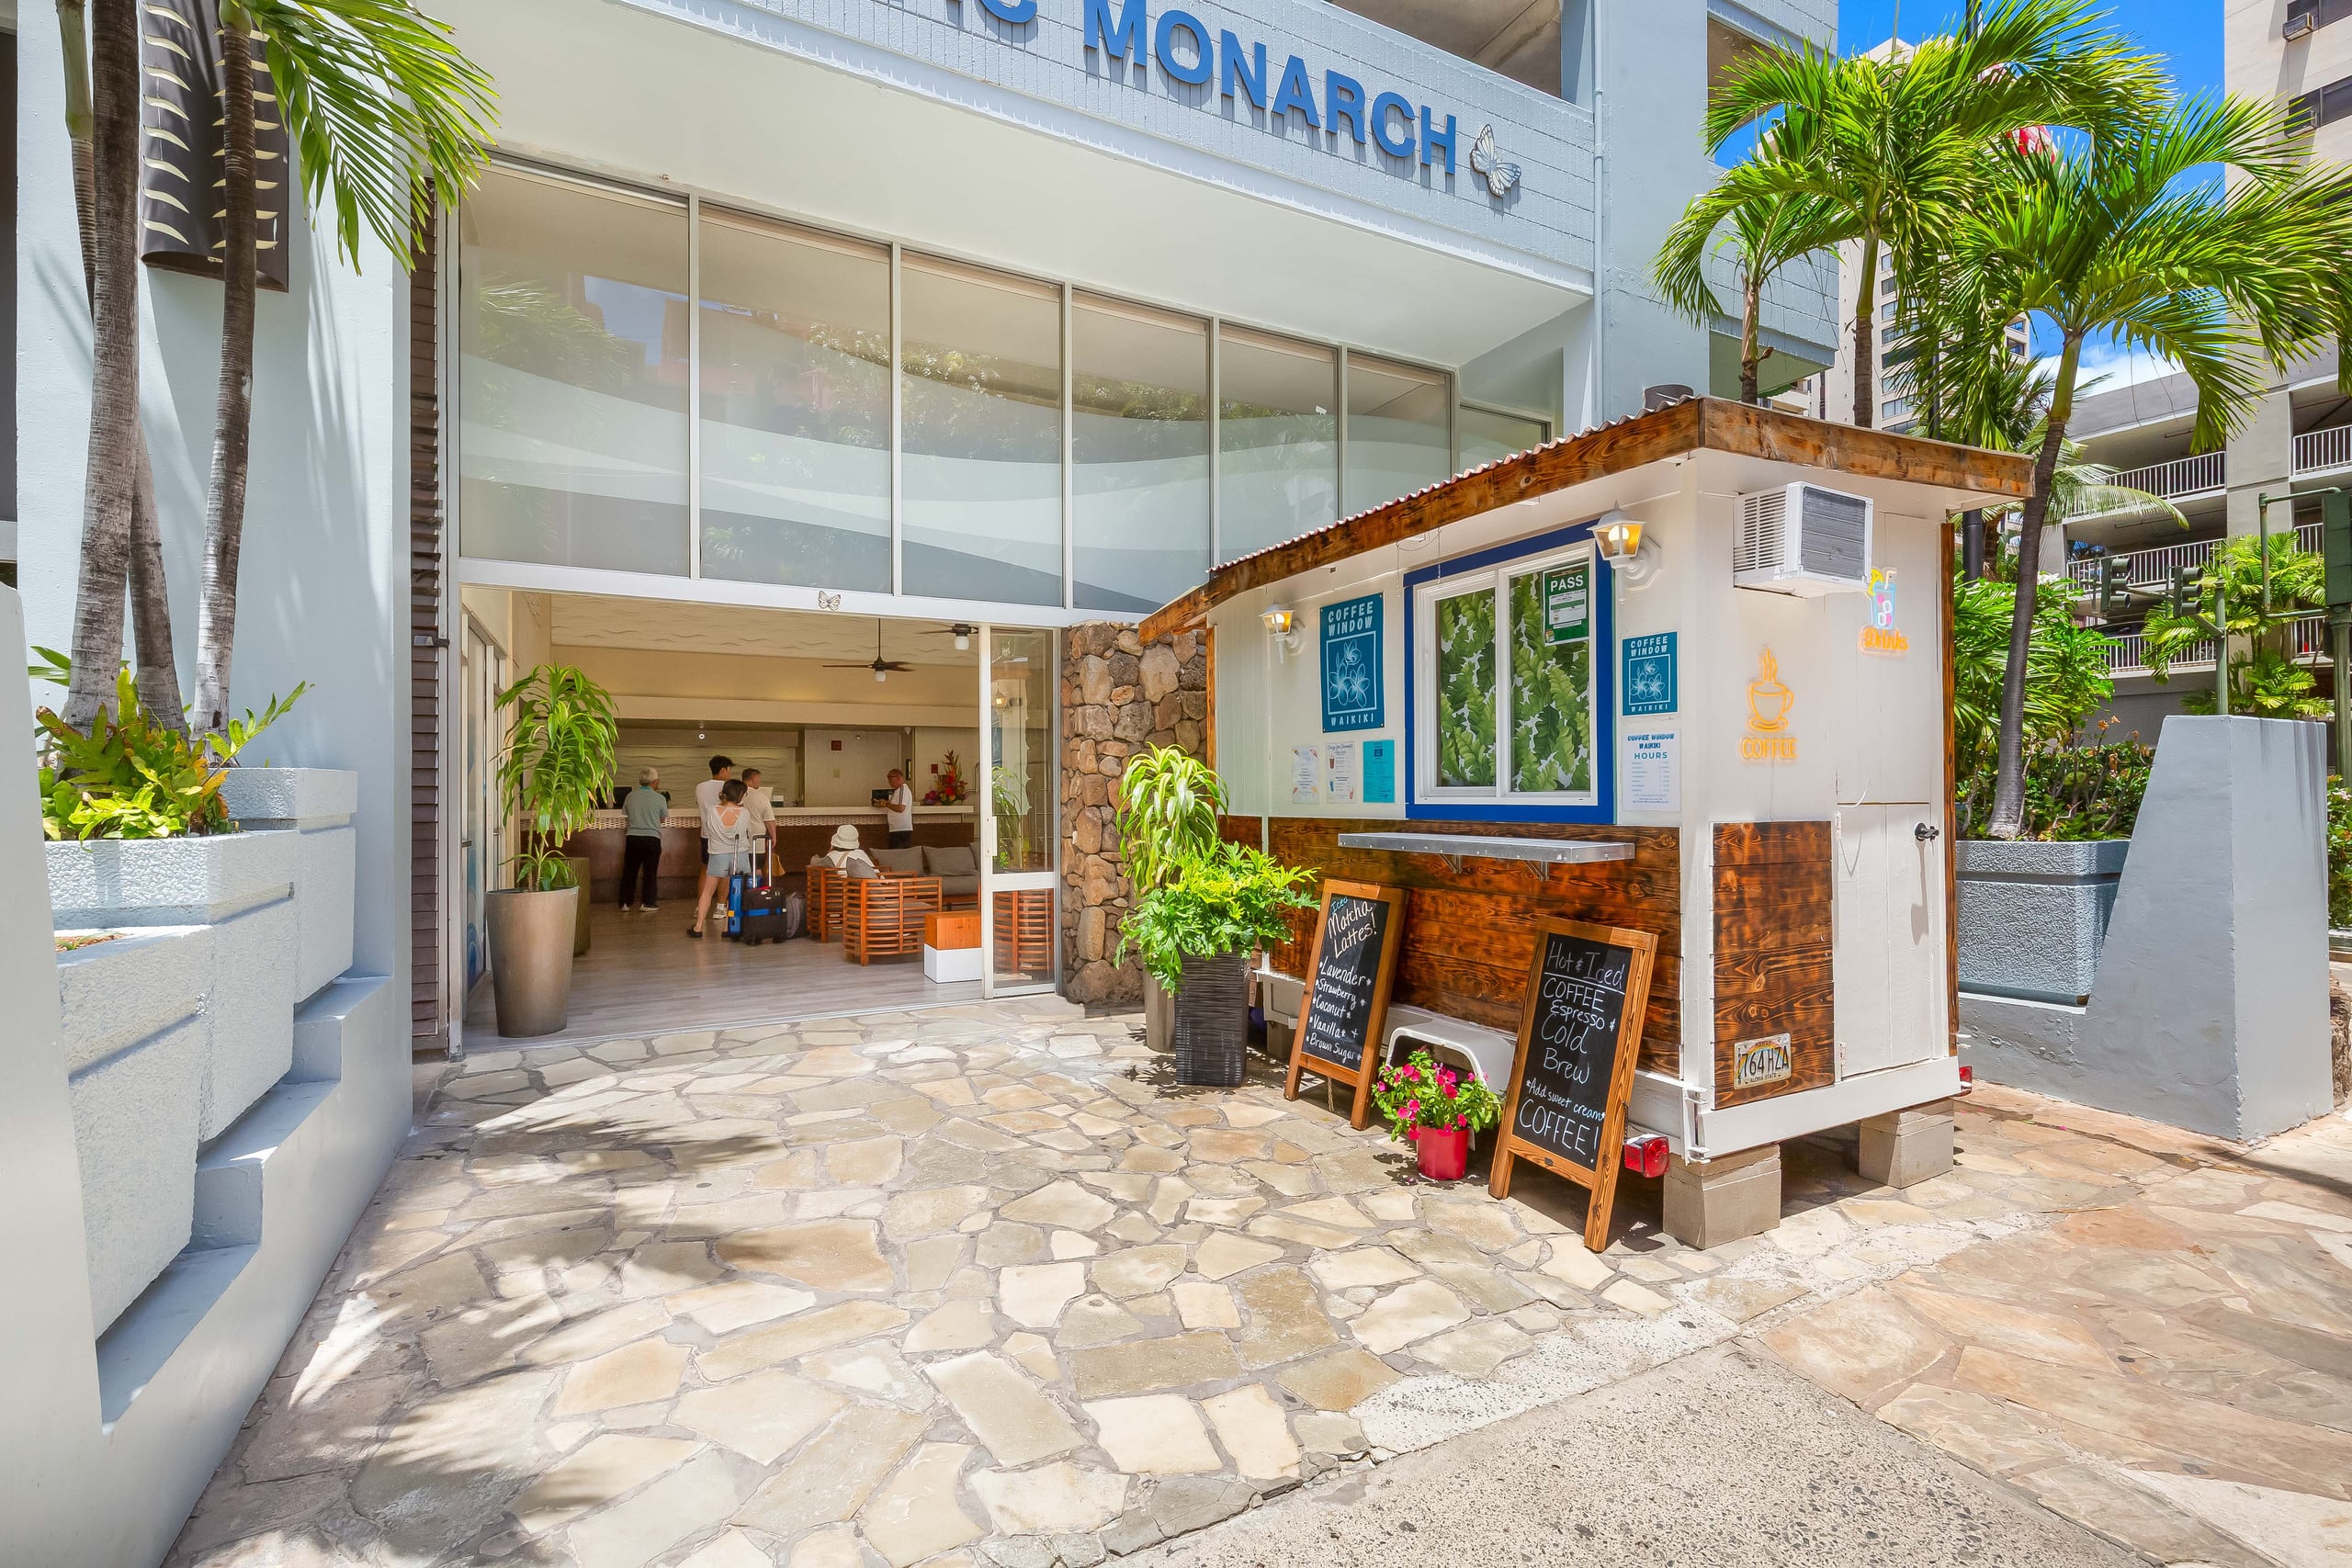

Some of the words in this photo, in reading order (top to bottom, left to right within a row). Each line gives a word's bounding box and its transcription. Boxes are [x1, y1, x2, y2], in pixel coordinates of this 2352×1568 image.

[1083, 0, 1456, 176] MONARCH
[1550, 575, 1584, 592] PASS
[1328, 601, 1374, 623] COFFEE
[1329, 615, 1373, 637] WINDOW
[1631, 636, 1668, 649] COFFEE
[1631, 645, 1668, 657] WINDOW
[1864, 626, 1909, 651] Drinks
[1330, 713, 1374, 727] WAIKIKI
[1631, 704, 1668, 713] WAIKIKI
[1634, 751, 1668, 760] HOURS
[1742, 738, 1798, 759] COFFEE
[1328, 900, 1373, 939] Matcha
[1331, 897, 1349, 914] Iced
[1334, 912, 1377, 959] Lattes!
[1319, 956, 1366, 986] Lavender
[1547, 941, 1575, 973] Hot
[1582, 952, 1625, 989] Iced
[1316, 994, 1347, 1018] Coconut
[1317, 977, 1357, 1010] Strawberry
[1543, 976, 1606, 1012] COFFEE
[1313, 1014, 1341, 1039] Vanilla
[1550, 999, 1605, 1030] Espresso
[1309, 1032, 1332, 1051] Brown
[1332, 1043, 1355, 1064] Sugar
[1541, 1013, 1589, 1054] Cold
[1543, 1047, 1590, 1085] Brew
[1741, 1050, 1765, 1078] 764
[1767, 1045, 1790, 1072] HZA
[1528, 1077, 1547, 1098] Add
[1547, 1091, 1572, 1108] sweet
[1573, 1103, 1603, 1122] cream
[1520, 1099, 1600, 1164] COFFEE!
